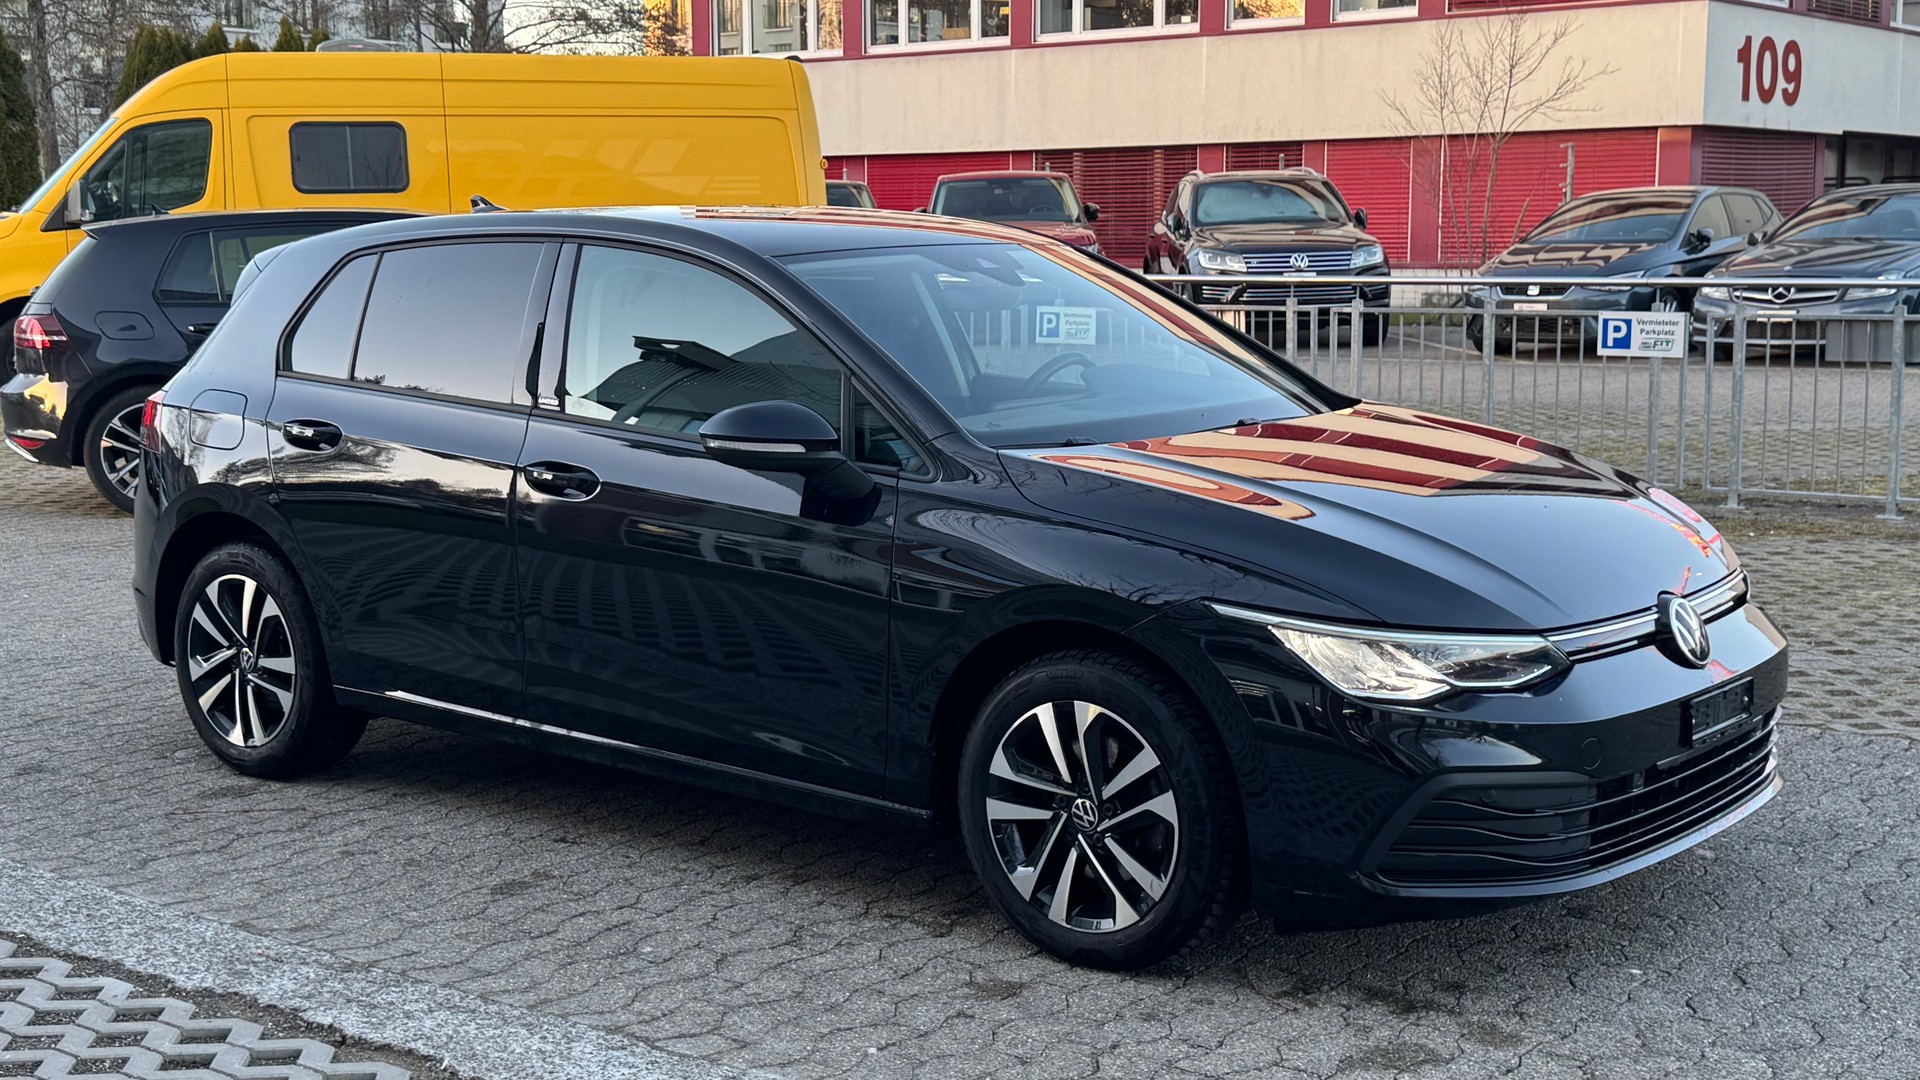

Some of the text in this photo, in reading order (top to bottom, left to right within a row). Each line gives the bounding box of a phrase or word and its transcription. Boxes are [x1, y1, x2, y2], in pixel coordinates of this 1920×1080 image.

[1737, 34, 1802, 107] 109
[1042, 313, 1057, 336] P
[1636, 318, 1680, 327] Vermieteter
[1607, 320, 1628, 347] P
[1639, 328, 1675, 337] Parkplatz
[1652, 340, 1672, 349] FIT
